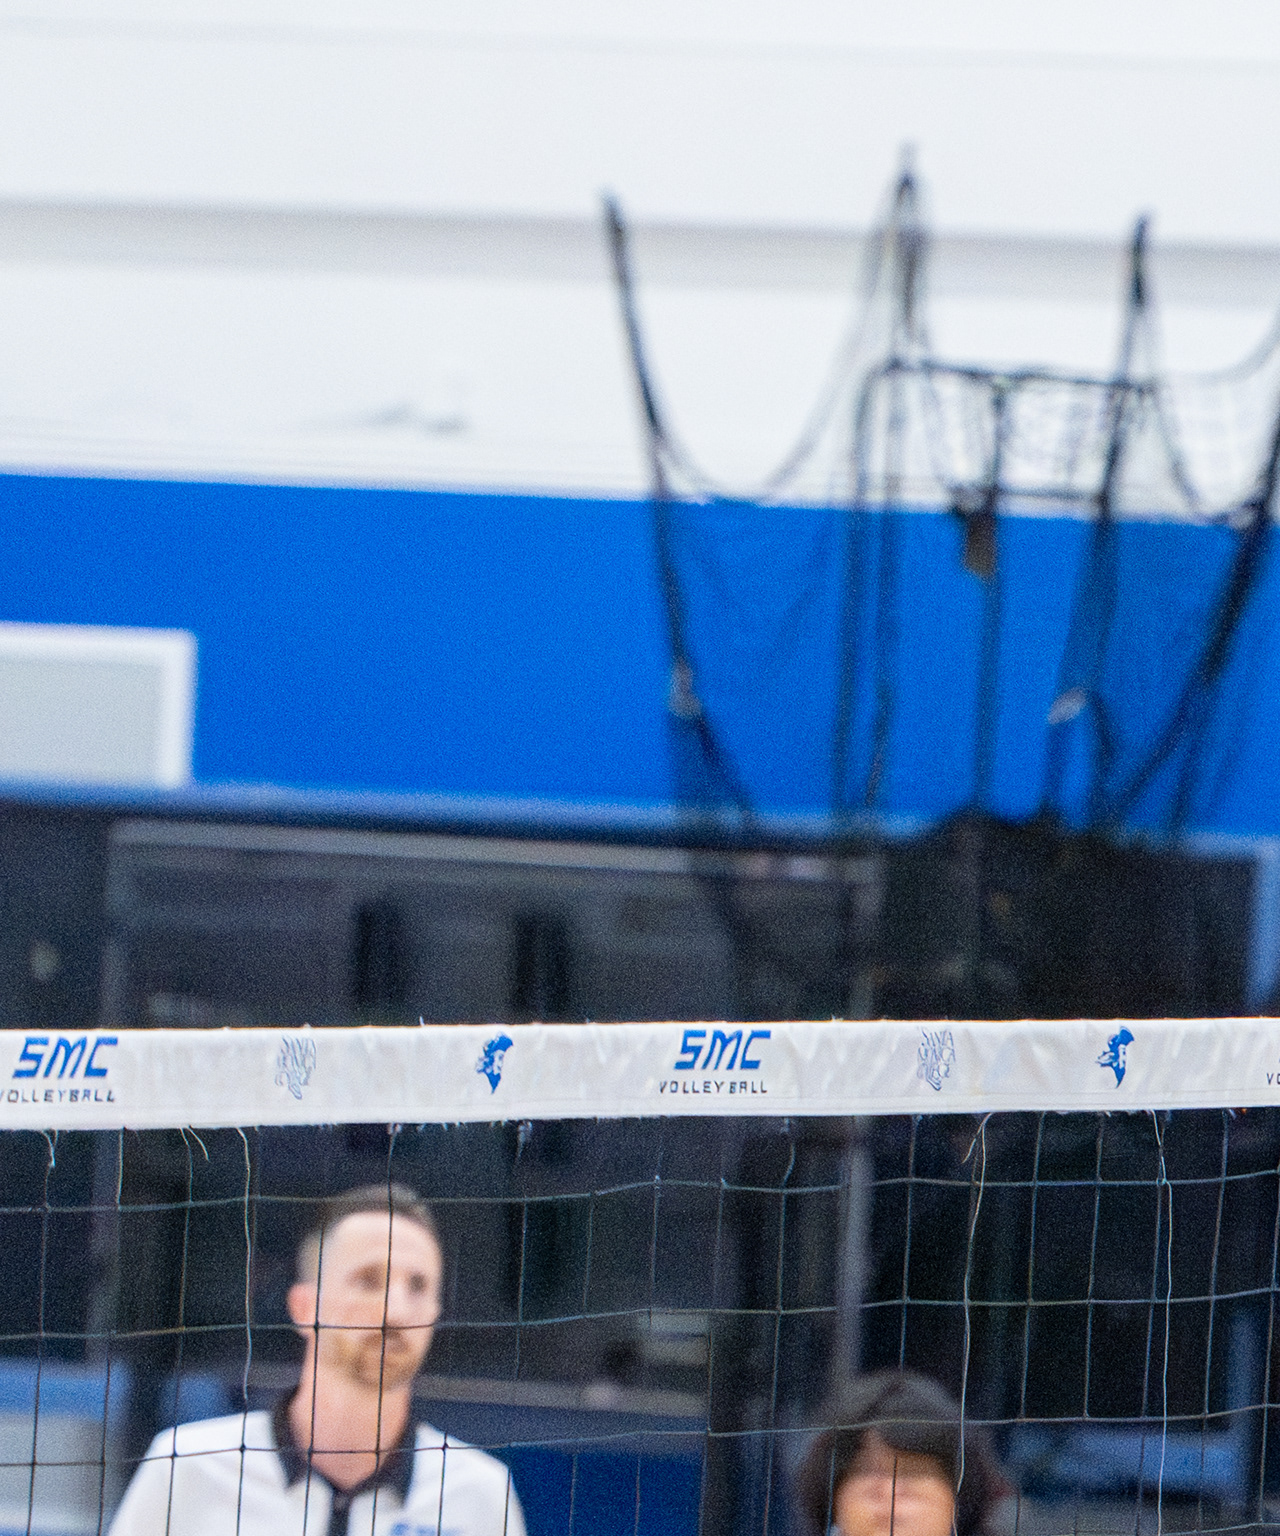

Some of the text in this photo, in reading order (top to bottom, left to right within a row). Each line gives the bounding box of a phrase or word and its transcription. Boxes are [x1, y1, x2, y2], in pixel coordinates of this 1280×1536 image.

[12, 1036, 118, 1079] SMC
[673, 1029, 771, 1070] SMC
[659, 1080, 768, 1095] VOLLEYBALL
